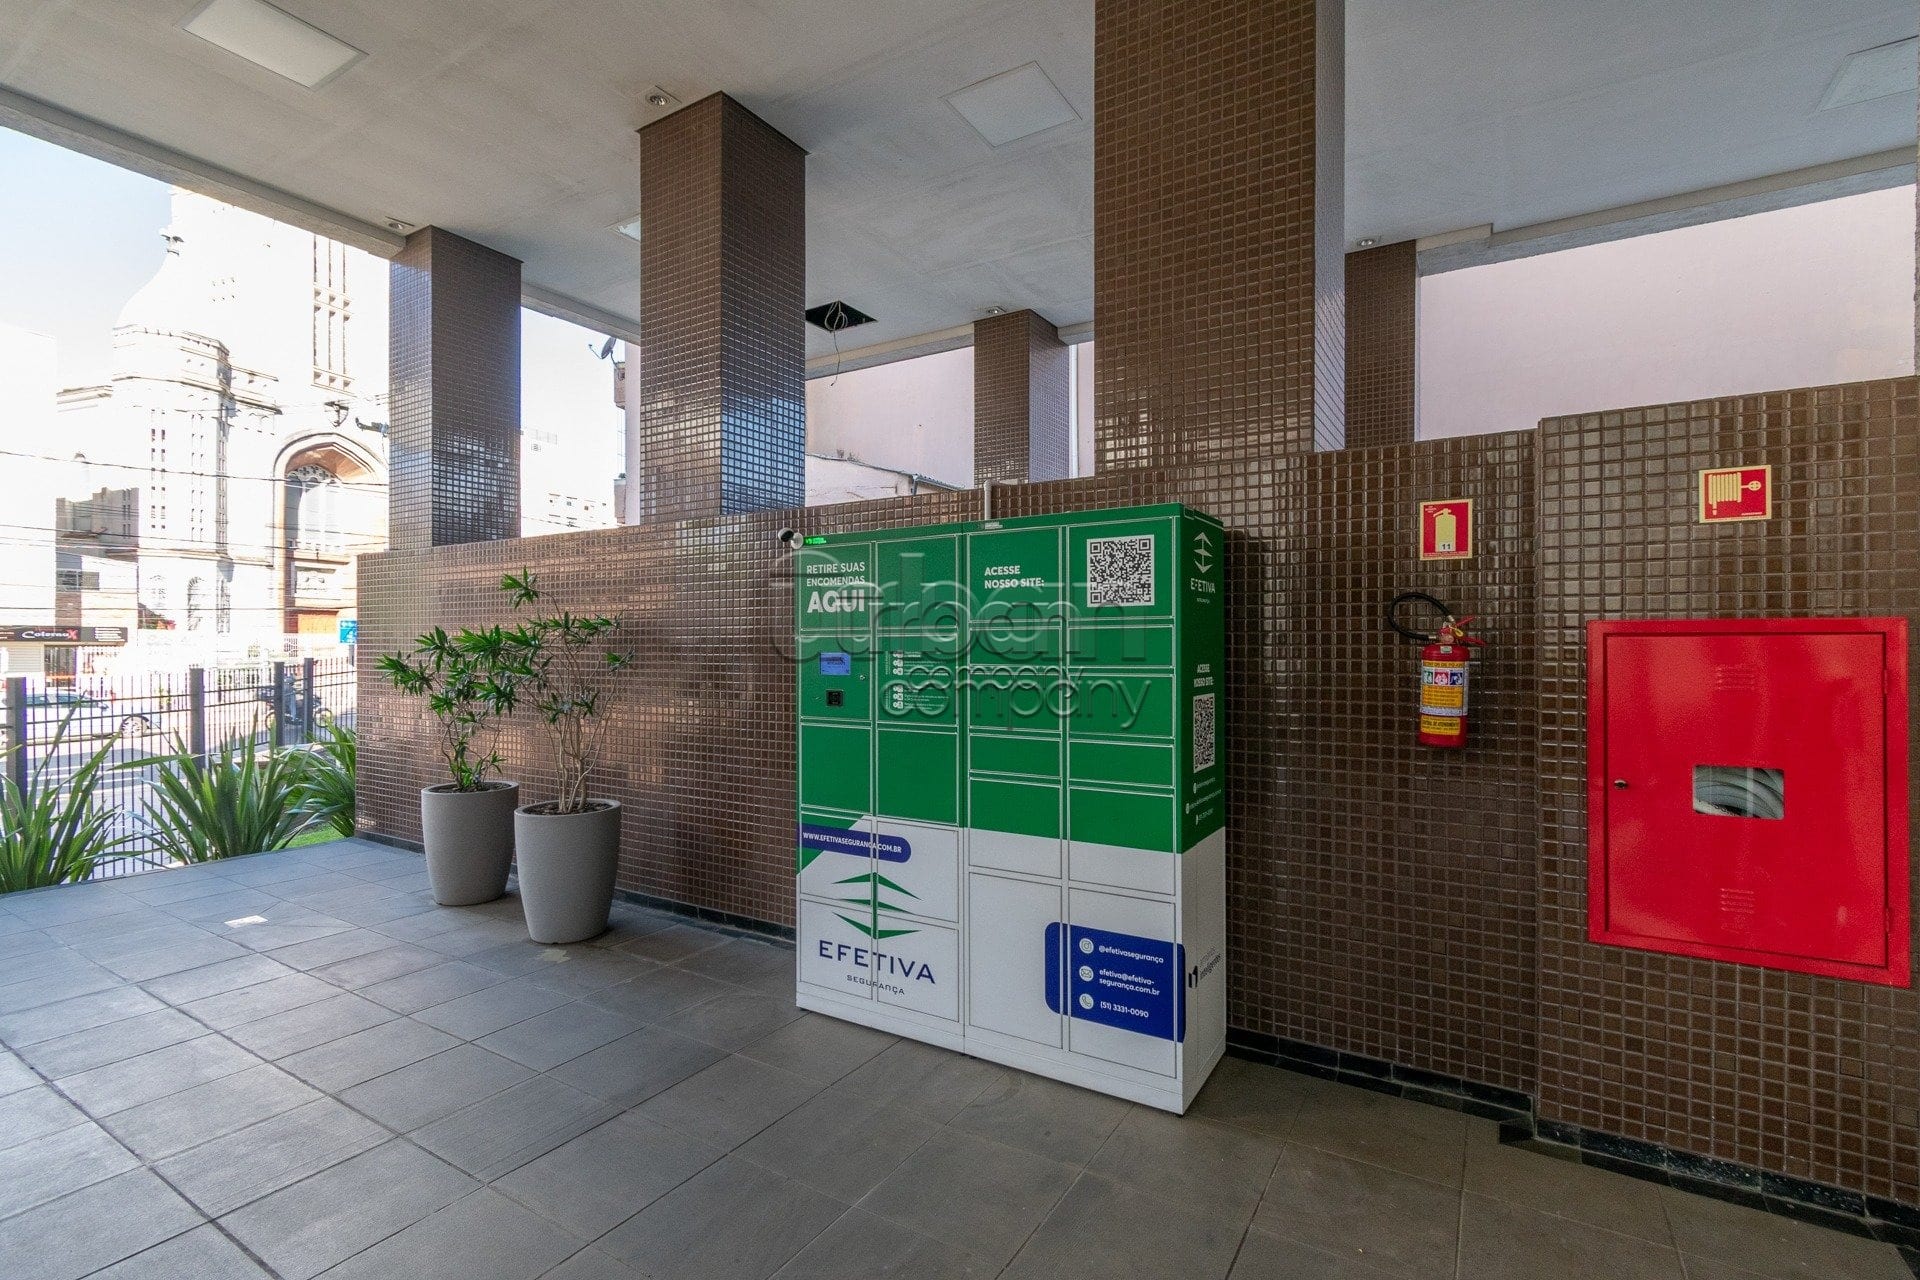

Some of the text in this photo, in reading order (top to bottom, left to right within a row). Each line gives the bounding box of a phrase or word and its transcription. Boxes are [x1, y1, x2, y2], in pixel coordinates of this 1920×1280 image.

[806, 562, 865, 574] RETIRE SUAS
[984, 565, 1020, 576] ACESSE
[806, 576, 865, 586] ENCOMENDAS
[984, 577, 1045, 589] NOSSO SITE:
[807, 589, 865, 613] AQUI
[819, 939, 936, 984] EFETIVA
[1098, 945, 1164, 964] @efetivasegurança
[846, 974, 905, 995] SEGURANÇA
[1099, 968, 1155, 986] efetiva@efetiva-
[1099, 978, 1160, 996] segurança.com.br
[1100, 1001, 1149, 1018] (51) 3331-0090
